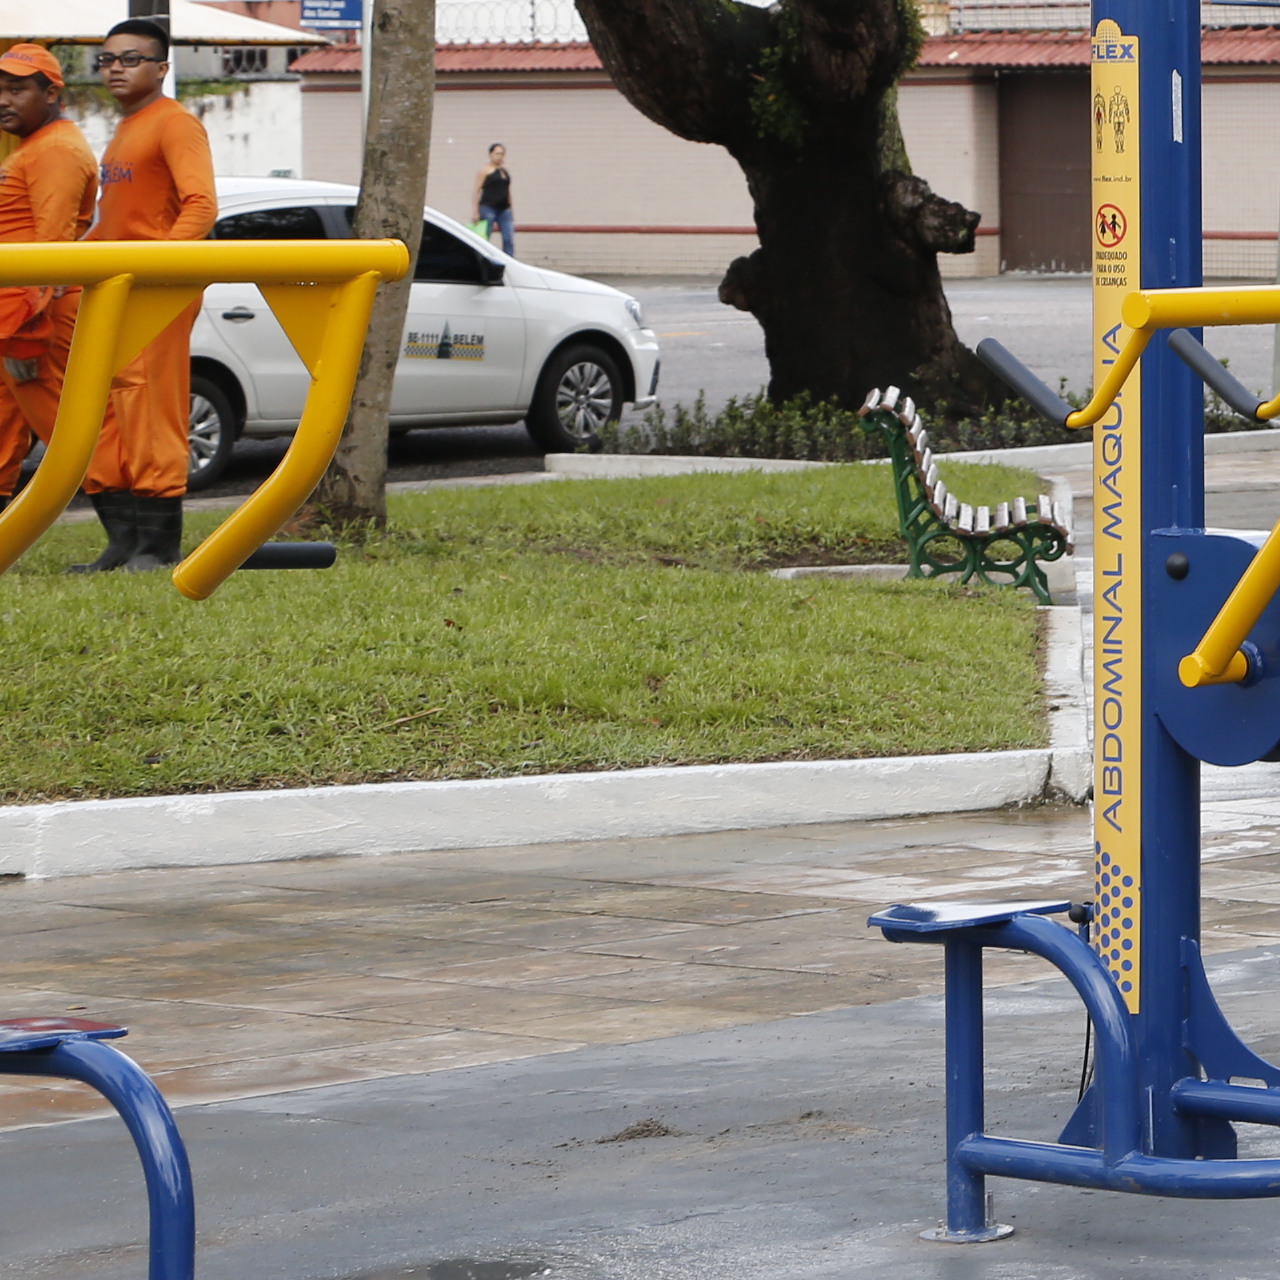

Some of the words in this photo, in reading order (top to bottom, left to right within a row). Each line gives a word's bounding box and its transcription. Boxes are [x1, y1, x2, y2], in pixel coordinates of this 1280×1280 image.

[1092, 44, 1135, 59] FLEX
[1108, 265, 1112, 273] O
[1113, 264, 1125, 273] USO
[1100, 323, 1122, 540] MÁQUA
[1102, 554, 1123, 833] ABDOMINAL
